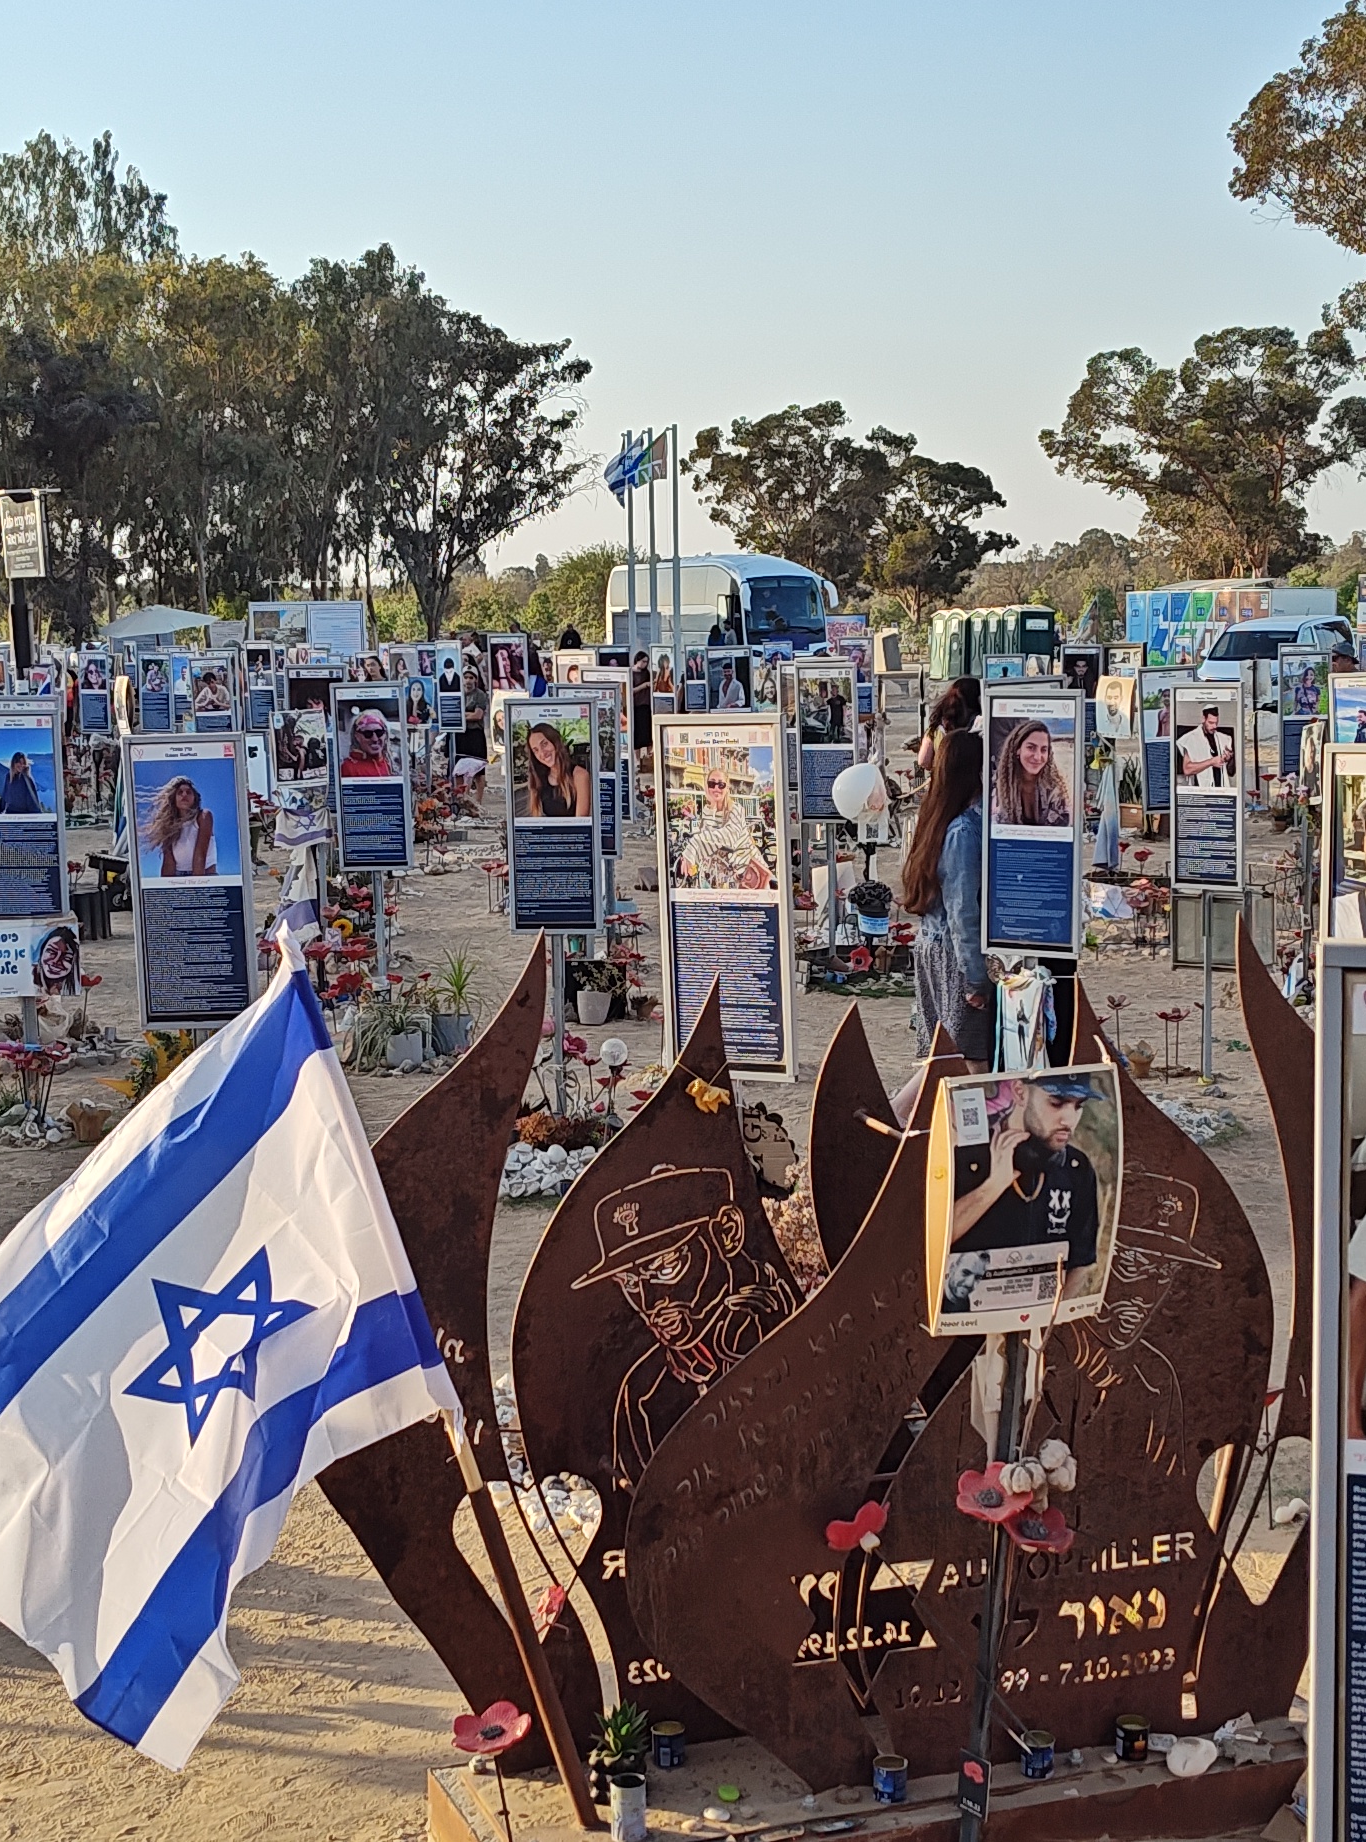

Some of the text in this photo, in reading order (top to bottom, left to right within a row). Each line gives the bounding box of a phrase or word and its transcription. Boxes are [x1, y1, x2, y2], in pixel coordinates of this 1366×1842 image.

[674, 1459, 719, 1496] אור
[970, 1586, 1167, 1650] נאור לי
[1058, 1647, 1176, 1686] 7.10.2023
